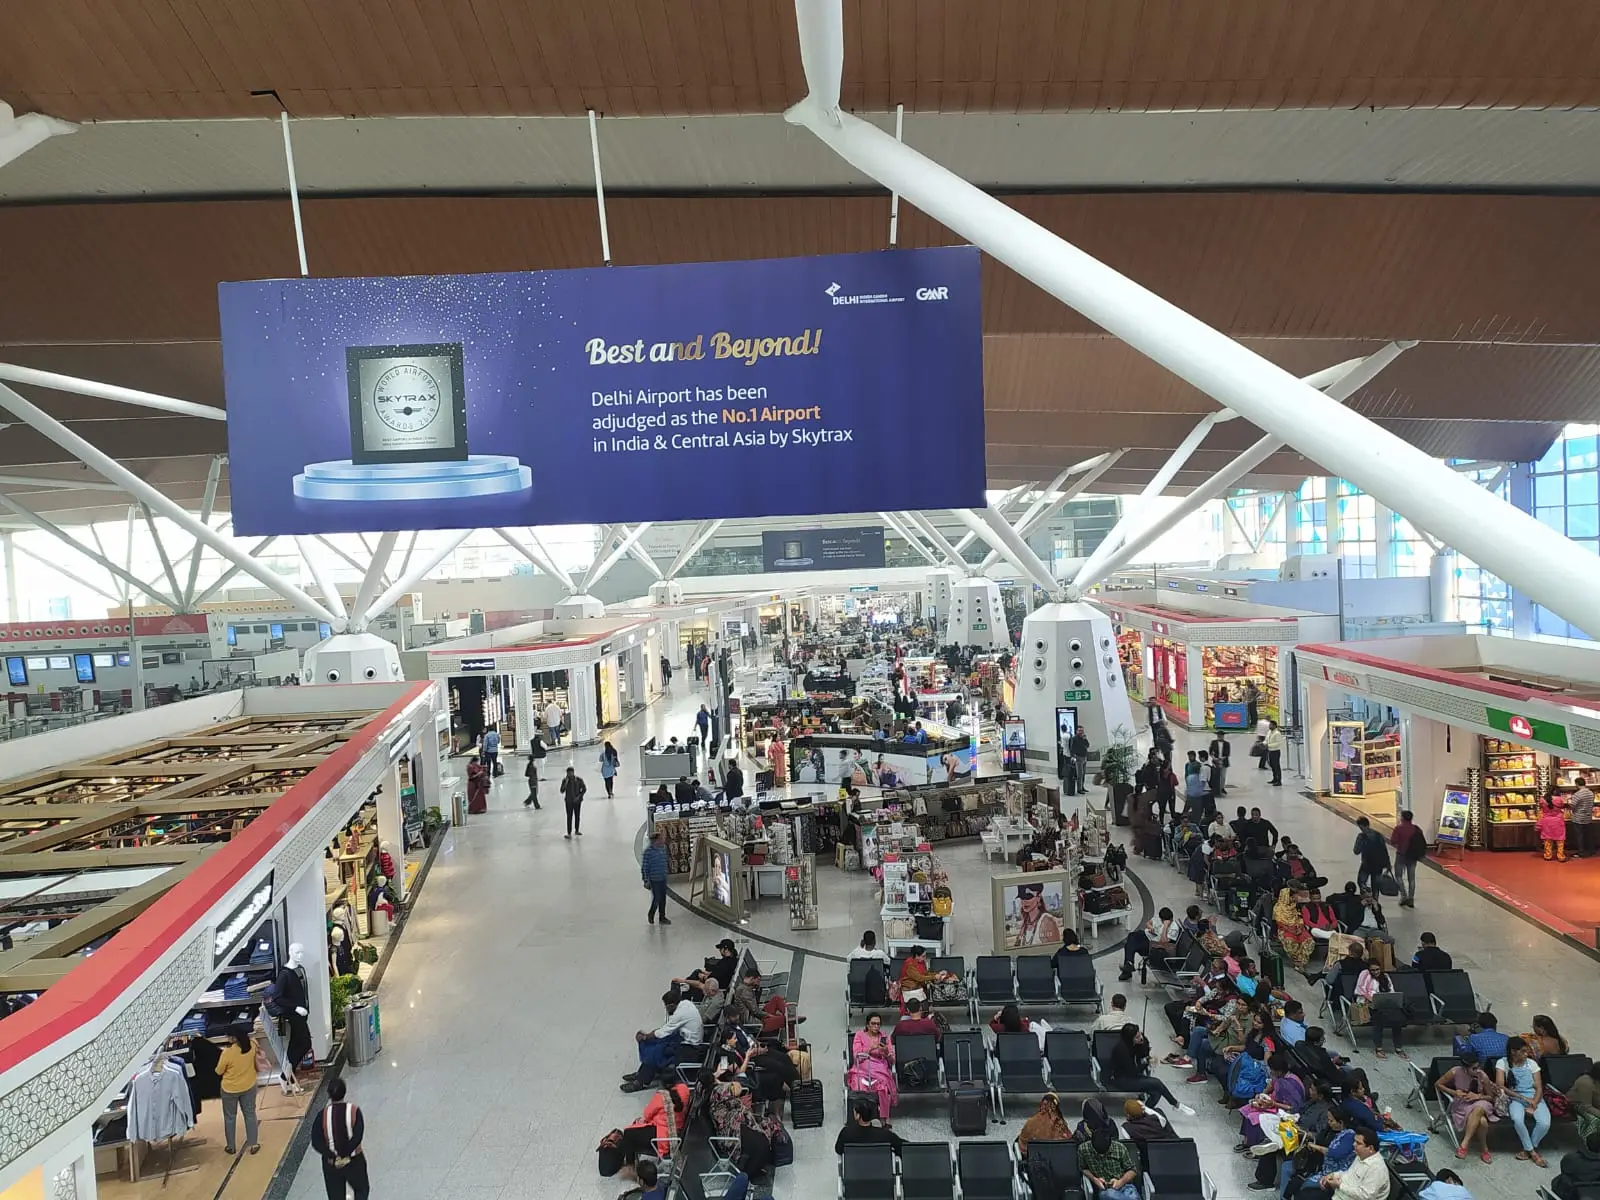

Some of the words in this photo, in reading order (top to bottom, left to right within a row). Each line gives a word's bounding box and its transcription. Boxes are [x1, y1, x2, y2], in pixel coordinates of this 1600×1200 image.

[832, 295, 859, 306] DELHI
[916, 286, 949, 301] GMR
[585, 337, 646, 366] Best
[649, 335, 706, 362] and
[710, 328, 823, 366] Beyond!
[378, 369, 401, 392] WORLD
[378, 394, 437, 403] SKYTRAX
[591, 389, 633, 407] Delhi
[636, 388, 692, 408] Airport
[696, 386, 723, 402] has
[727, 385, 768, 401] been
[592, 411, 667, 433] adjudged
[670, 413, 688, 426] as
[691, 409, 718, 425] the
[721, 407, 757, 424] No.1
[760, 405, 822, 425] Airport
[593, 437, 607, 452] in
[611, 435, 650, 452] India
[653, 434, 668, 449] &
[671, 433, 730, 450] Central
[732, 430, 766, 447] Asia
[769, 429, 789, 448] by
[792, 428, 853, 447] Skytrax
